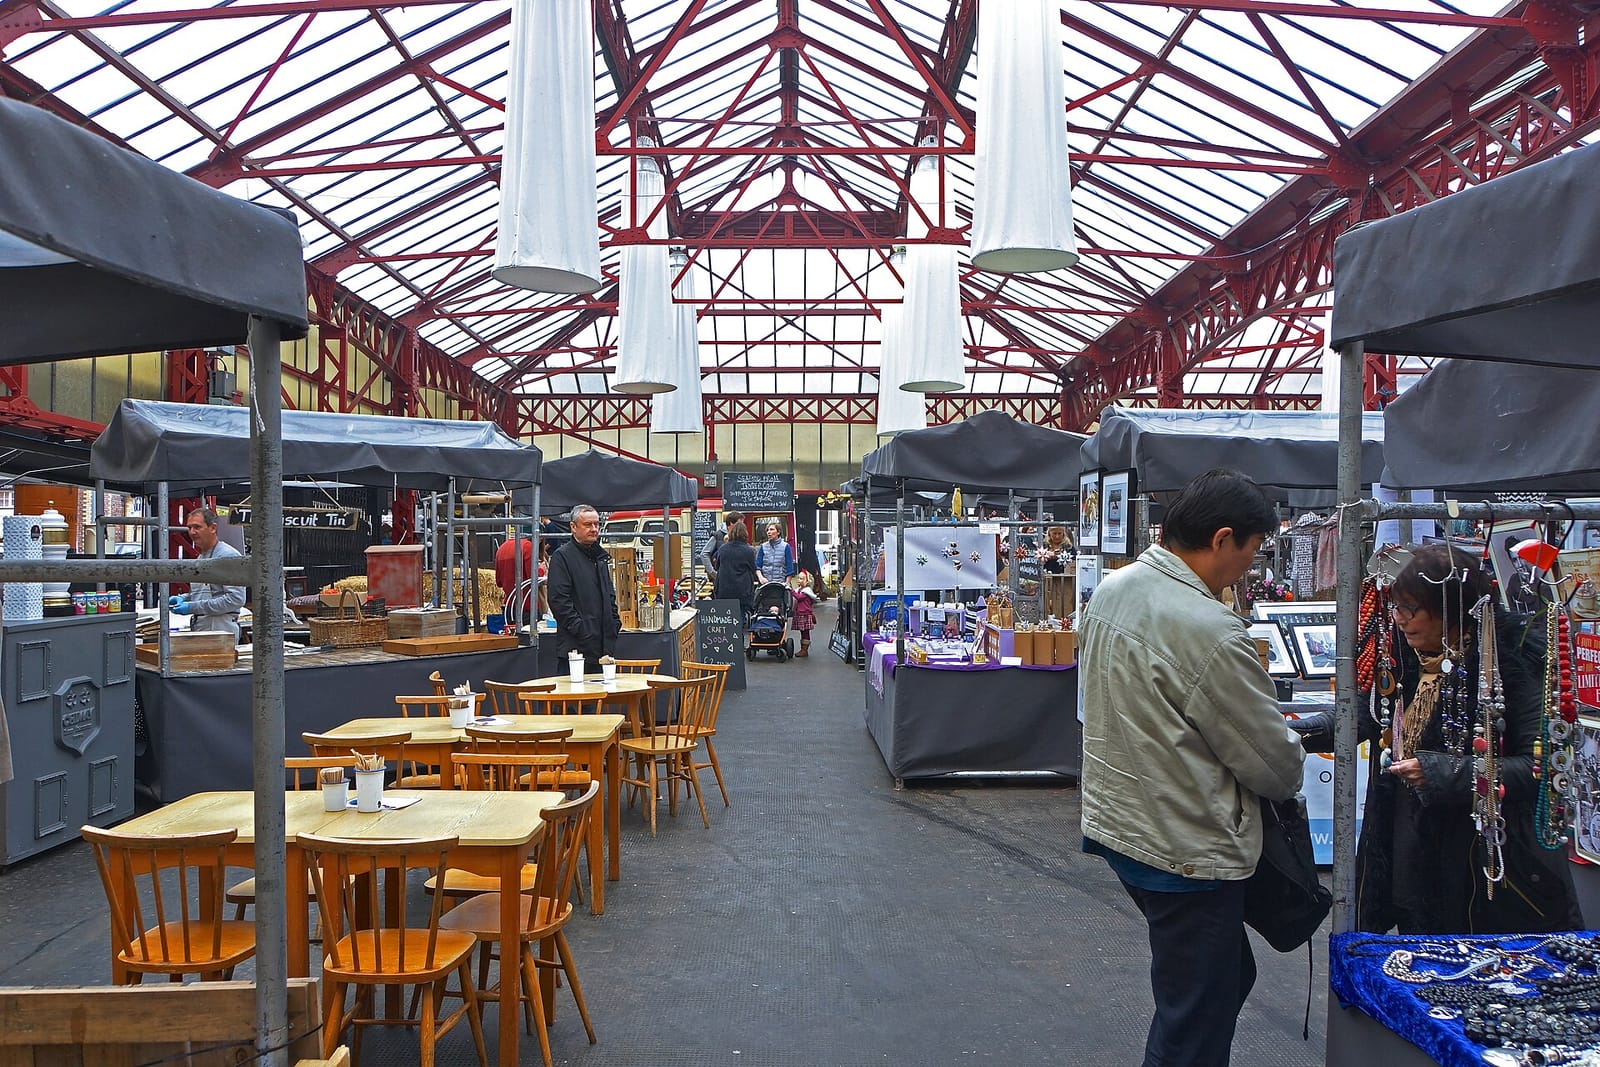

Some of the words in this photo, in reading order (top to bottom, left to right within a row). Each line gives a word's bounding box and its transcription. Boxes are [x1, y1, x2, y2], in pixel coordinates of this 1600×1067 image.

[282, 513, 318, 527] iscuit
[325, 513, 346, 526] Tin
[700, 615, 732, 624] HANDMADE
[707, 625, 727, 634] CRAFT
[706, 636, 729, 645] SODA
[1311, 833, 1333, 845] w.
